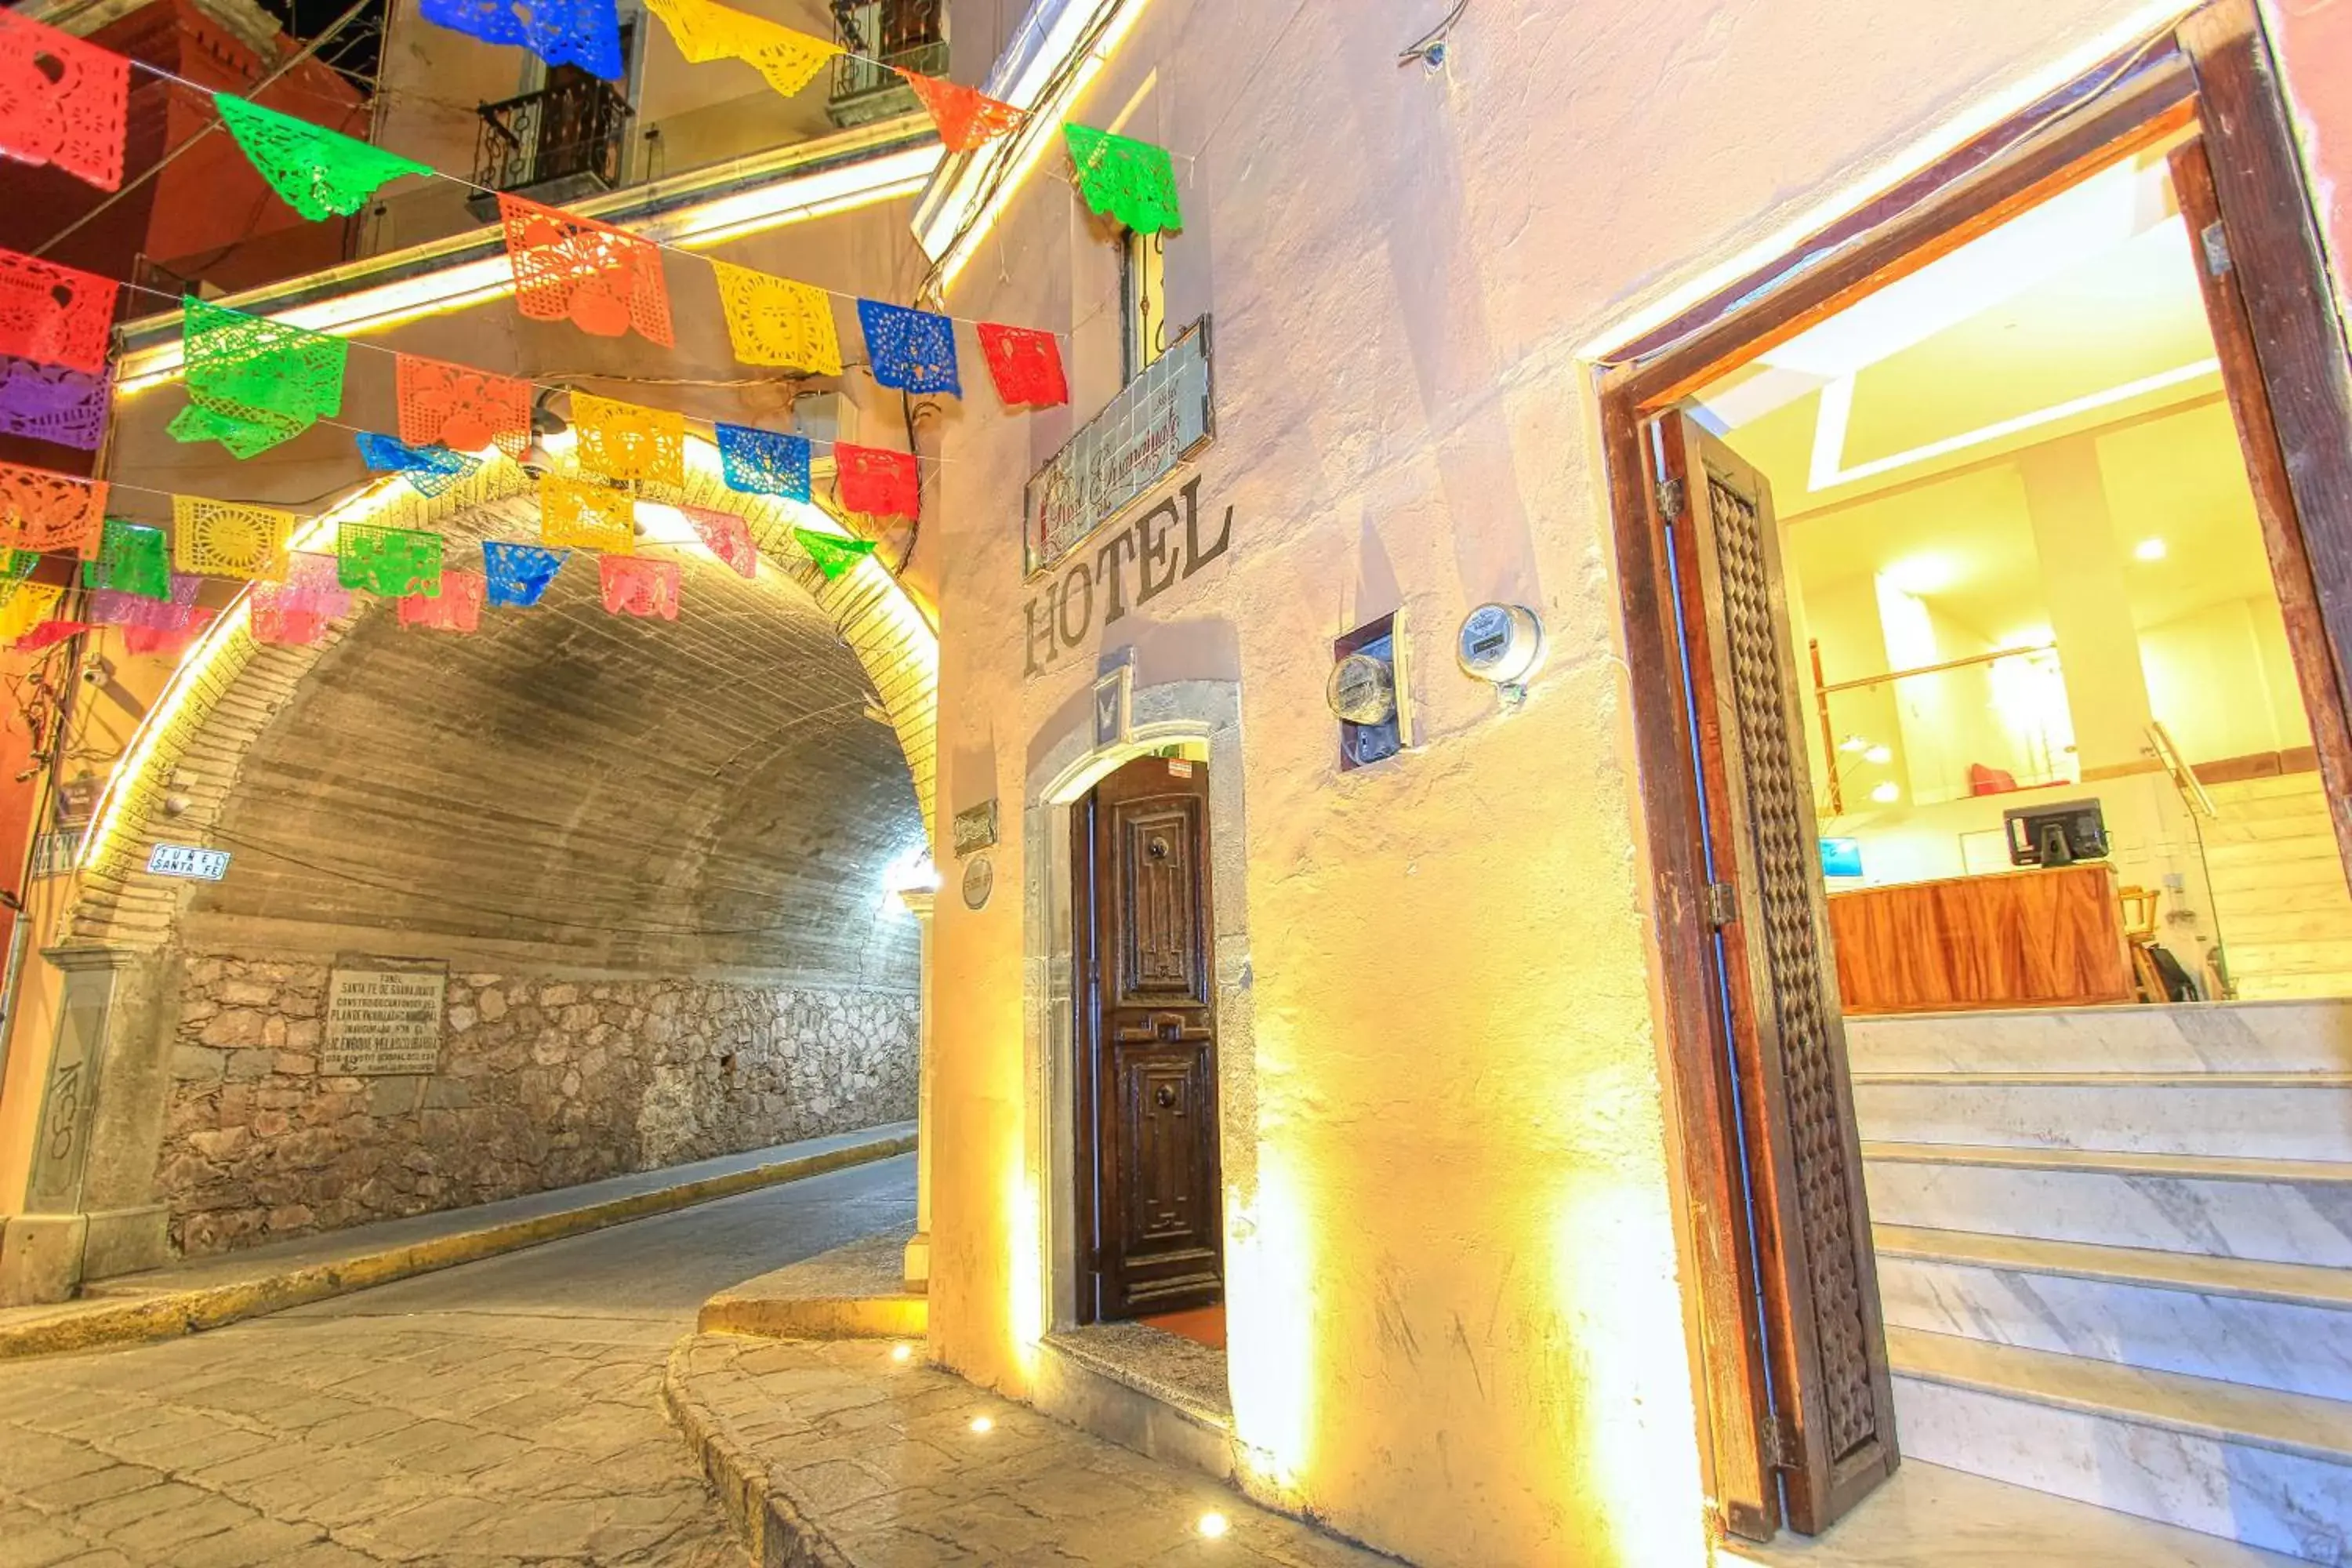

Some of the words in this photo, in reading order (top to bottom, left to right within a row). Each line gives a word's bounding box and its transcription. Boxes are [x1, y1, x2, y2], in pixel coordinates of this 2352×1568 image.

[1024, 474, 1233, 681] HOTEL
[156, 858, 194, 873] SANTA
[204, 865, 220, 876] FE
[340, 983, 365, 995] SANTA
